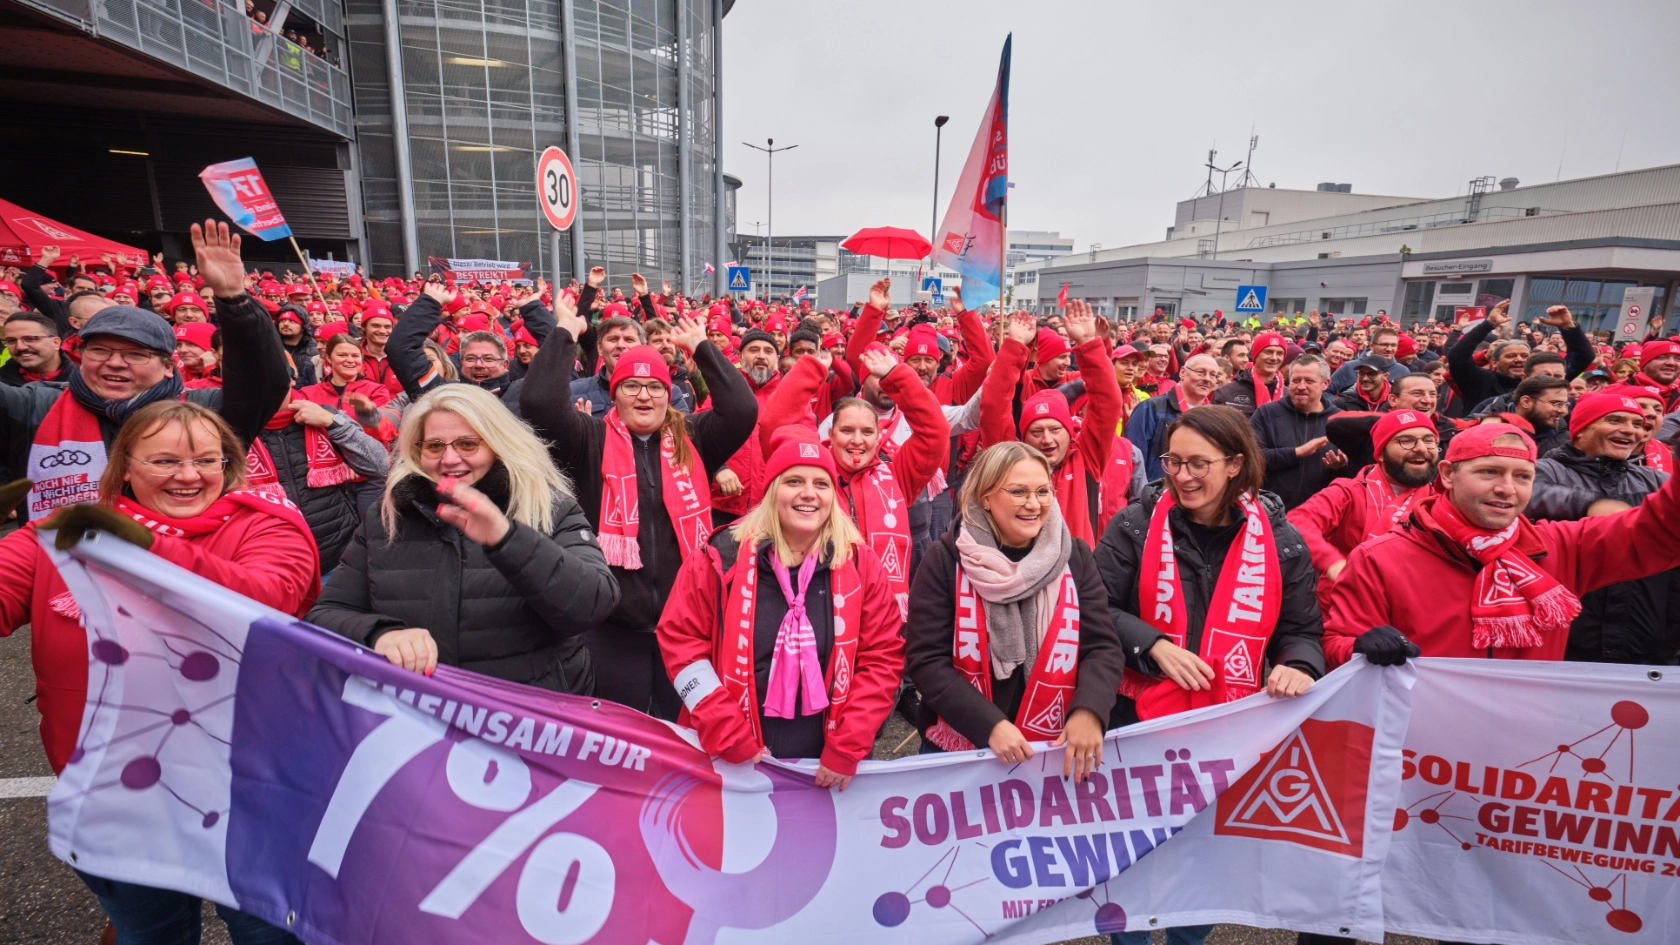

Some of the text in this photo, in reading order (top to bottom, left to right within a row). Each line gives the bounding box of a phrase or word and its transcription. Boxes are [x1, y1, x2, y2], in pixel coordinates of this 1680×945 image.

[547, 169, 569, 208] 30
[456, 270, 508, 280] BESTREIKT!
[1425, 262, 1488, 272] Besucher-Eingang
[33, 500, 51, 512] ALS
[35, 478, 59, 492] NOCH
[358, 676, 574, 757] EINSAM
[307, 674, 616, 945] 7%
[879, 748, 1236, 849] SOLIDARITÄT
[1477, 802, 1680, 860] GEWINN
[990, 826, 1184, 889] GEWI
[1475, 832, 1680, 878] TARIFBEWEGUNG 2
[1002, 899, 1033, 919] MIT
